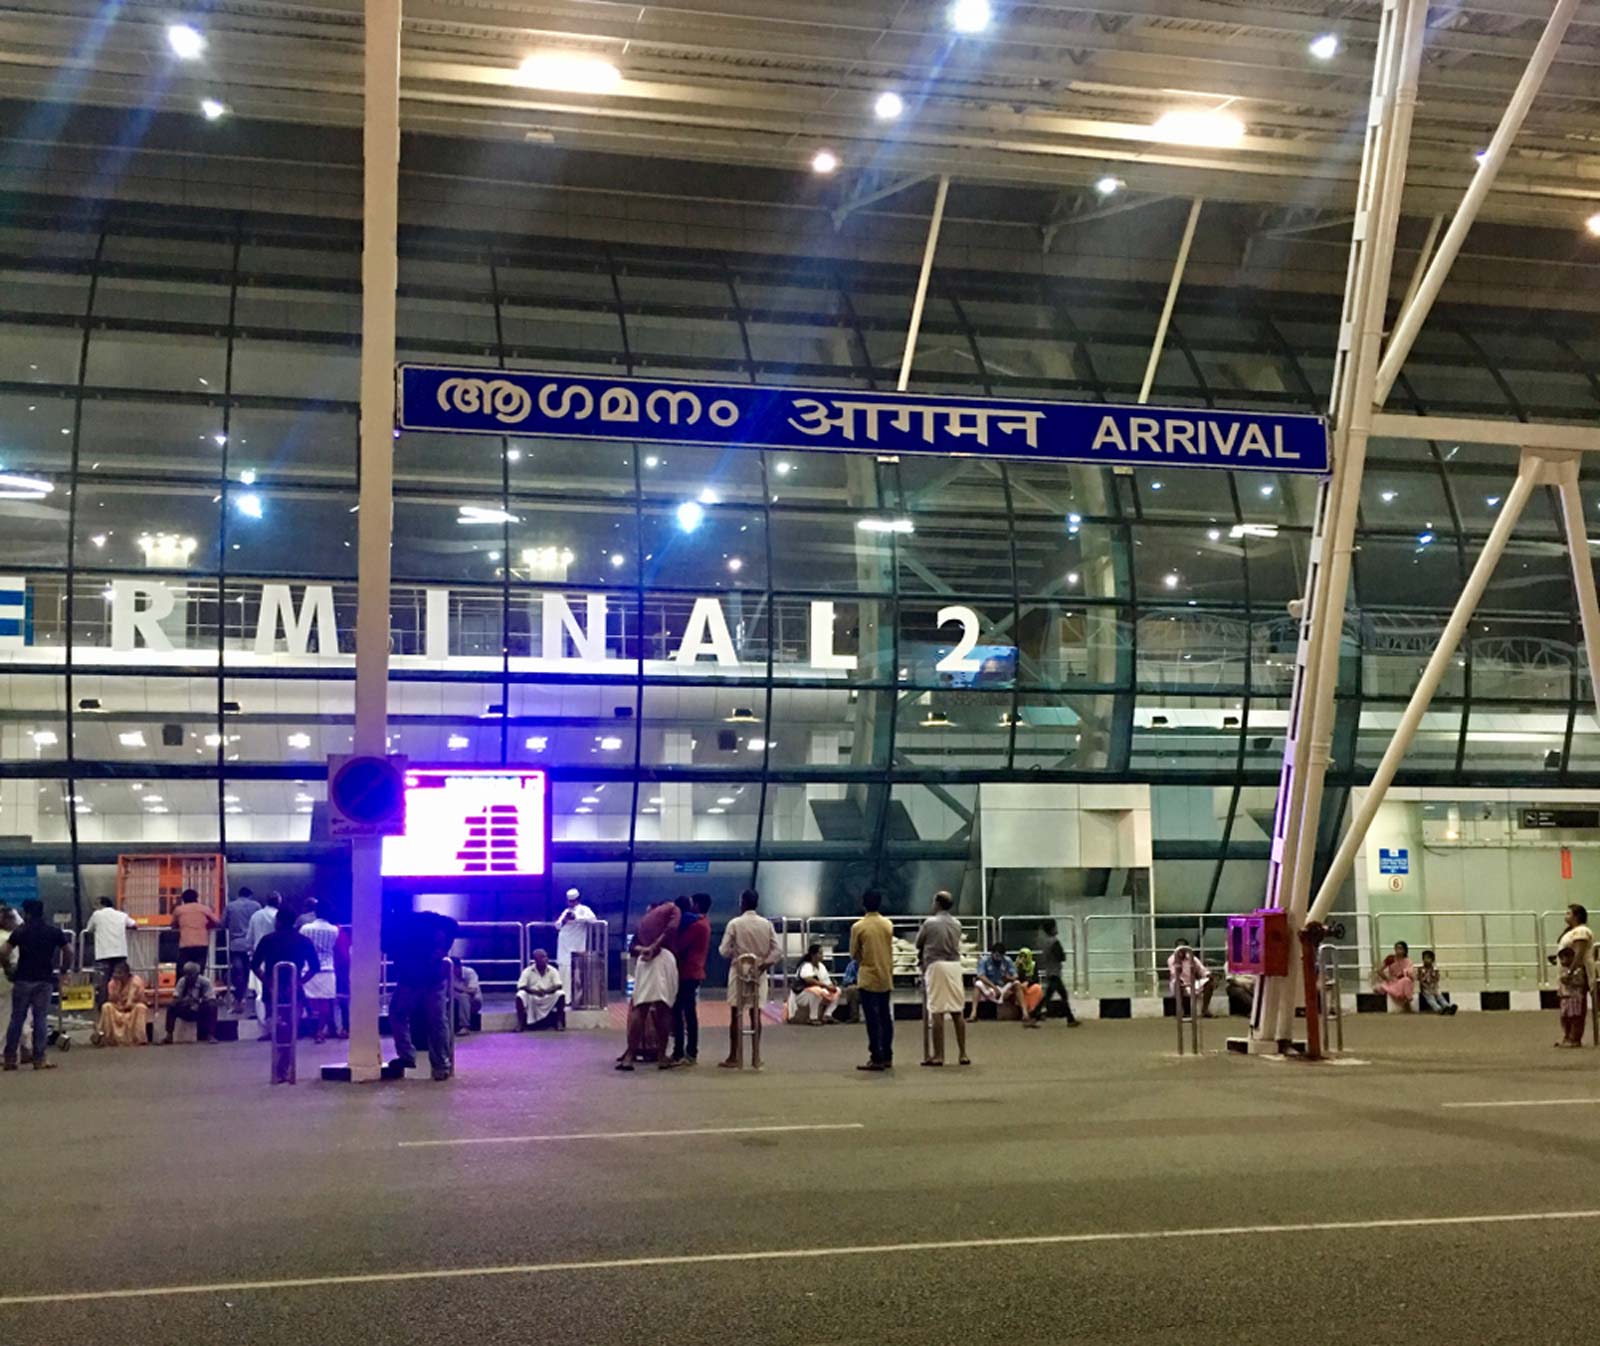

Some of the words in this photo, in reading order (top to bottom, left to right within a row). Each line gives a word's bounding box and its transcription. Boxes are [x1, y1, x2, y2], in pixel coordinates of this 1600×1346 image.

[436, 376, 740, 427] ആഗമനം
[787, 397, 1047, 449] आगमन
[1091, 415, 1301, 460] ARRIVAL
[935, 605, 980, 672] 2
